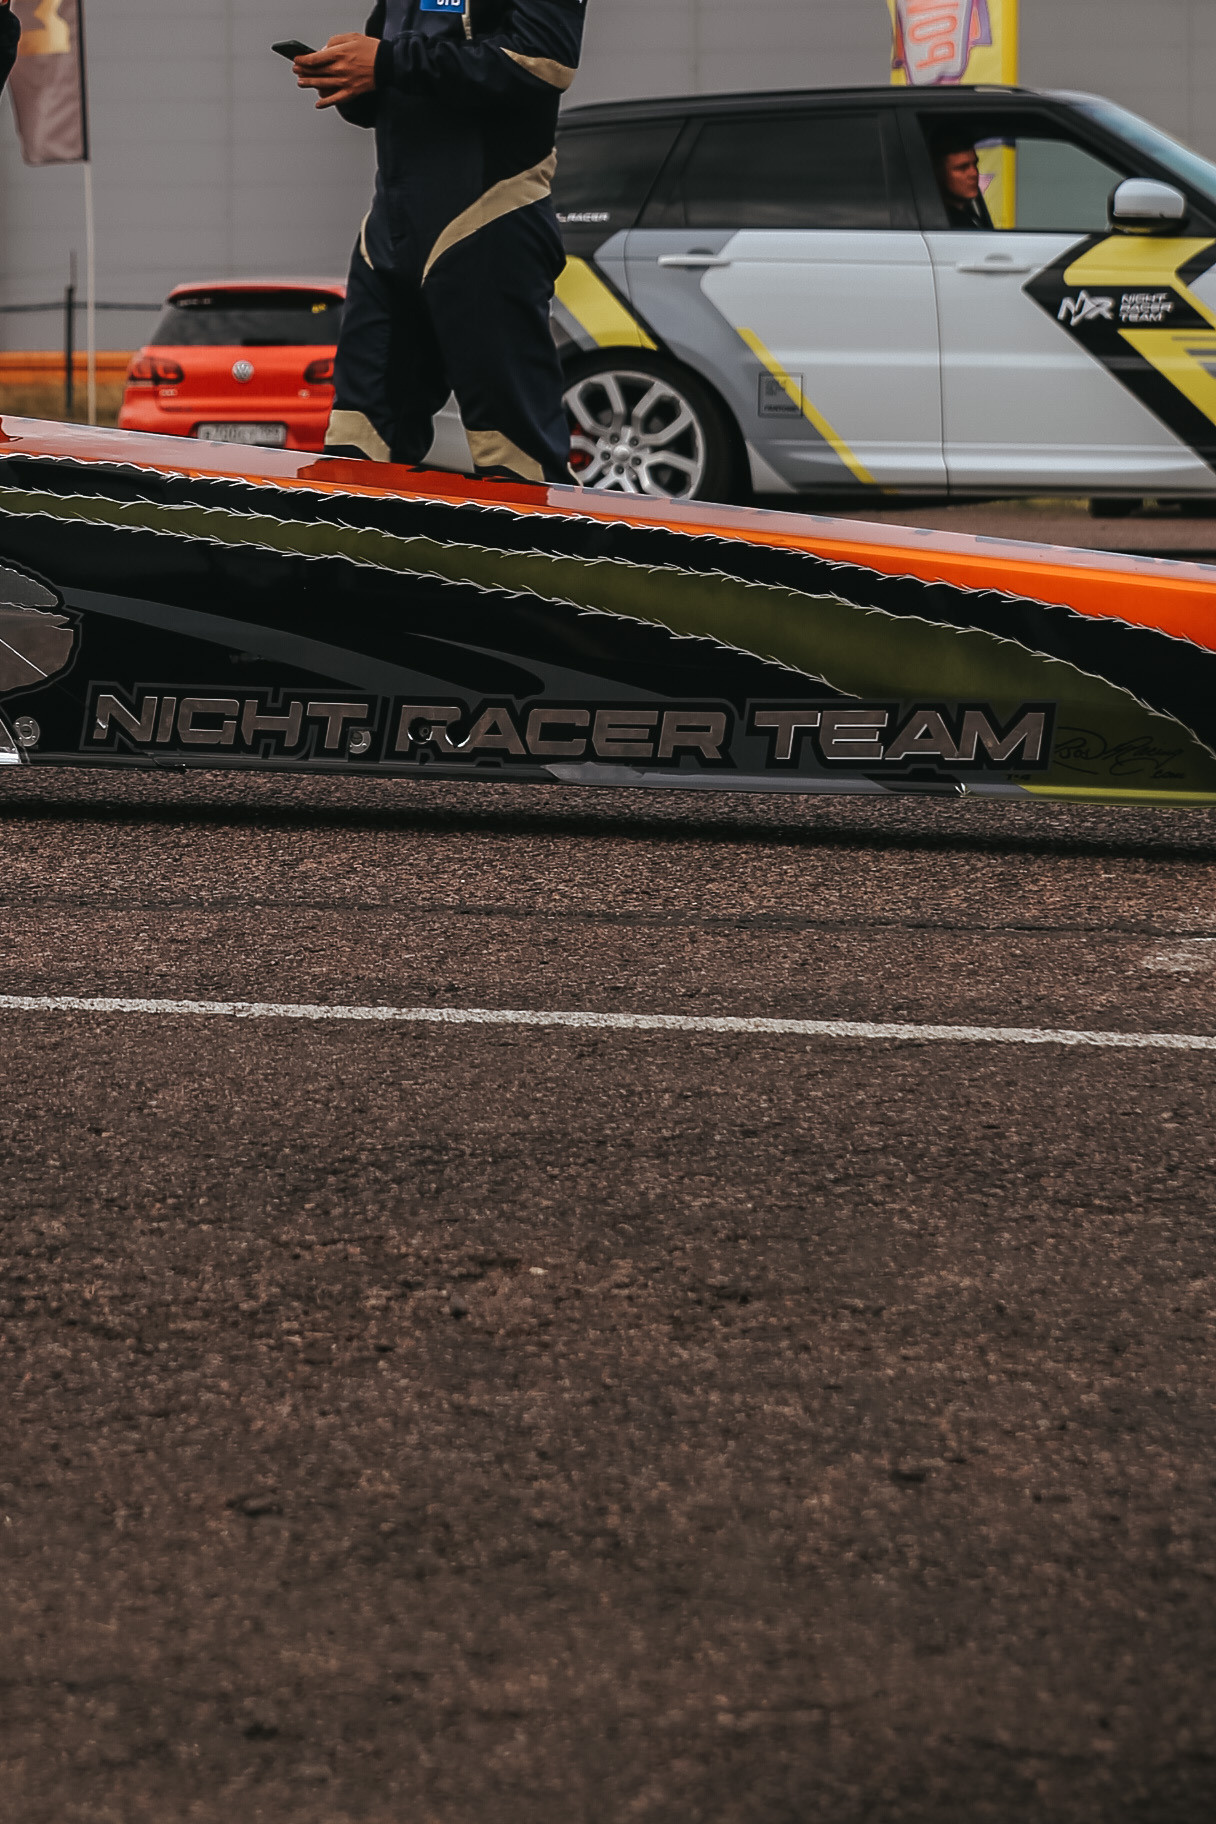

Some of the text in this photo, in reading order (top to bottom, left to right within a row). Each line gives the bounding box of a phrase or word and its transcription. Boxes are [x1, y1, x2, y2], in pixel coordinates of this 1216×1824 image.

[1121, 293, 1168, 303] NIGHT
[1120, 302, 1174, 313] RACER
[1121, 313, 1164, 322] TEAM
[93, 693, 1045, 761] NIGHT RACER TEAM
